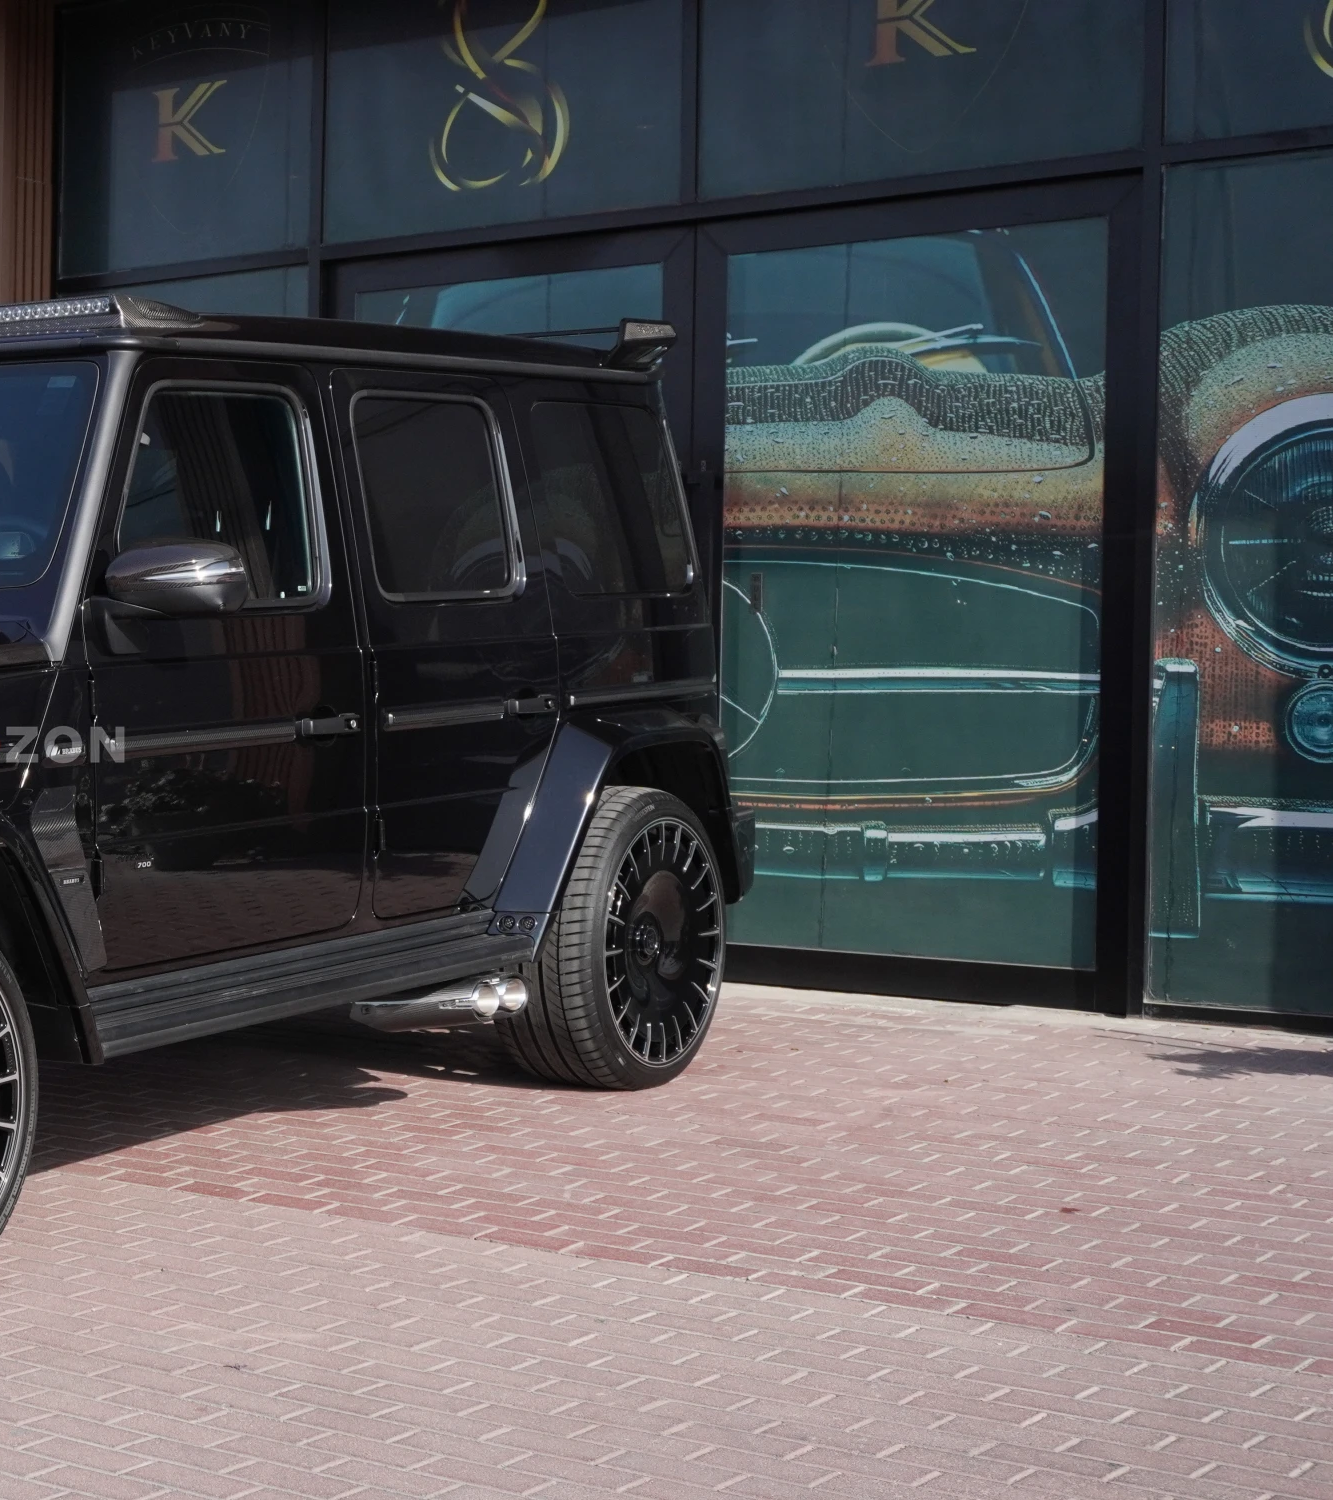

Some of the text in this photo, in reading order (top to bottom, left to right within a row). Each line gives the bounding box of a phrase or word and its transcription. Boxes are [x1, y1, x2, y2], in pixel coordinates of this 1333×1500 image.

[131, 22, 251, 61] KEYVANY
[152, 79, 228, 163] K
[137, 860, 152, 869] 700
